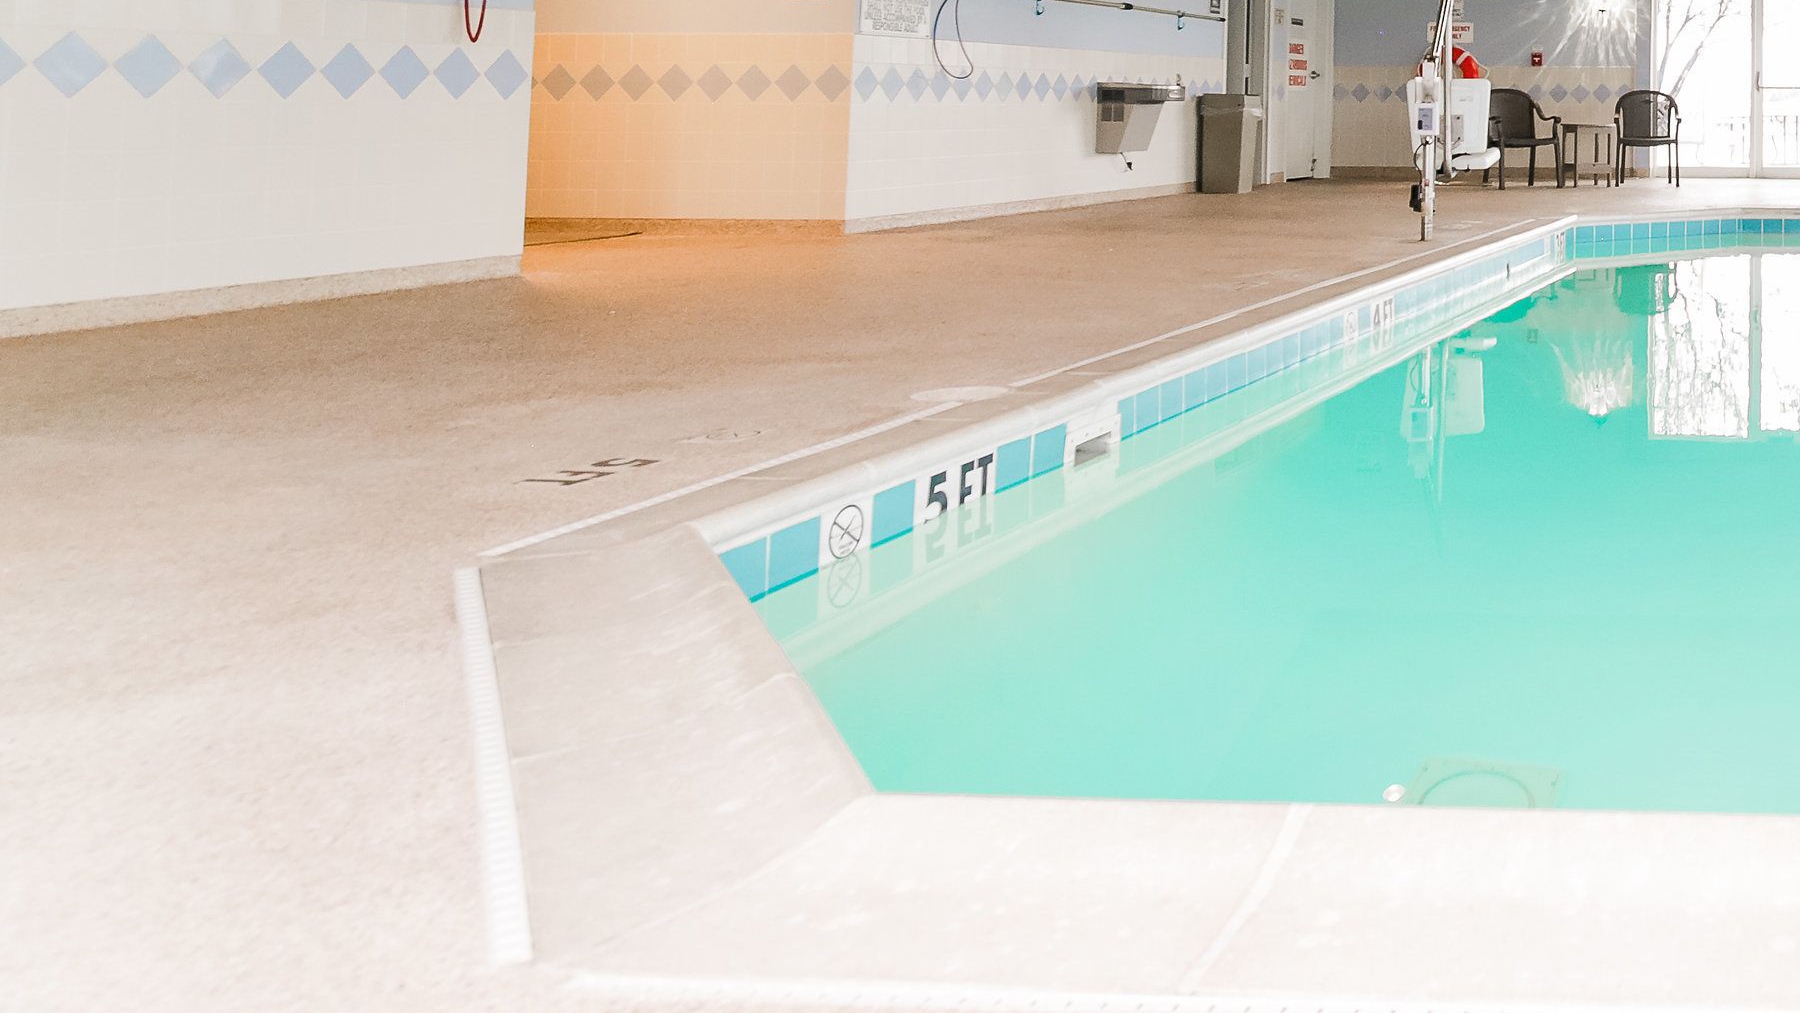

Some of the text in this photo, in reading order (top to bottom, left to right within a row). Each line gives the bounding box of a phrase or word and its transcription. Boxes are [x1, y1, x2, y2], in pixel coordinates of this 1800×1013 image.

[1373, 298, 1392, 325] 4 FT
[924, 453, 993, 524] 5 FT
